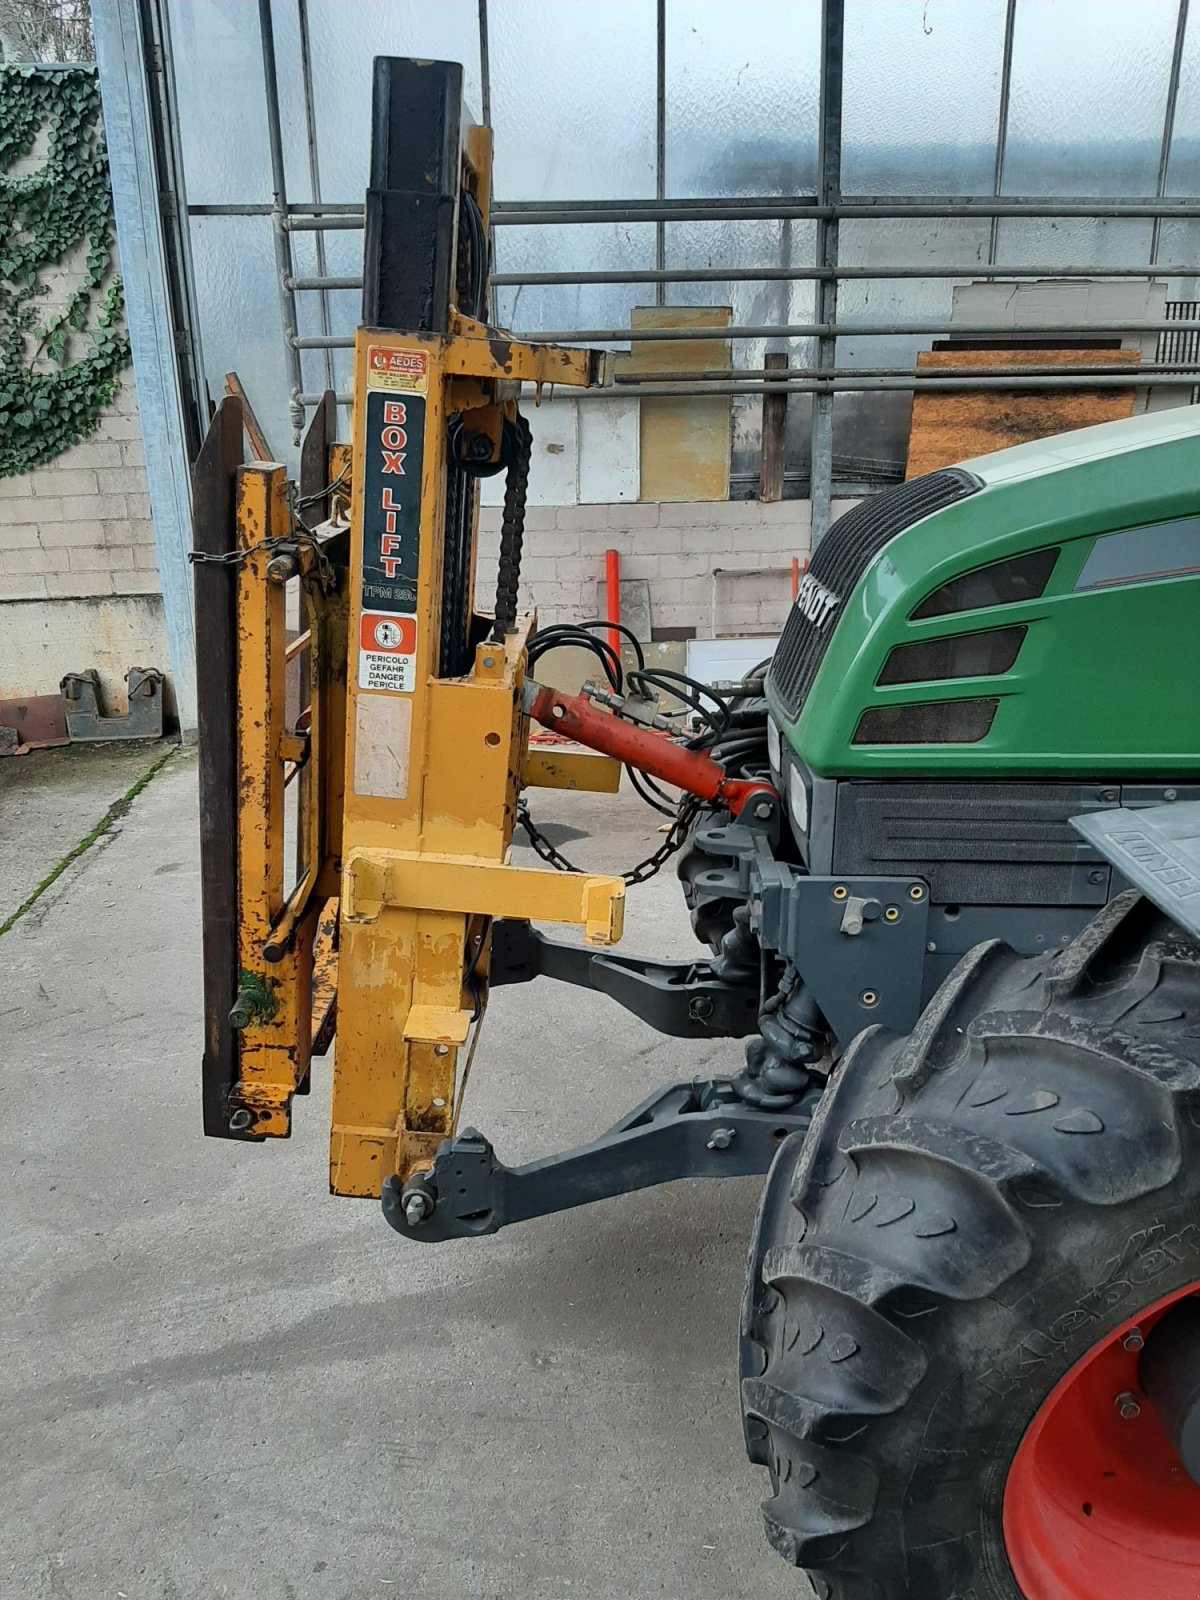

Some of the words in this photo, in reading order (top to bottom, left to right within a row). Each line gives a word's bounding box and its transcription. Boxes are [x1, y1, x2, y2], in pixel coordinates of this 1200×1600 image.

[389, 356, 424, 369] AEDES
[381, 401, 407, 475] BOX
[380, 488, 402, 578] LIFT
[363, 585, 392, 599] TPM
[366, 654, 409, 665] PERICOLO
[370, 663, 405, 673] GEFAHR
[369, 672, 405, 682] DANGER
[368, 680, 405, 690] PERICLE
